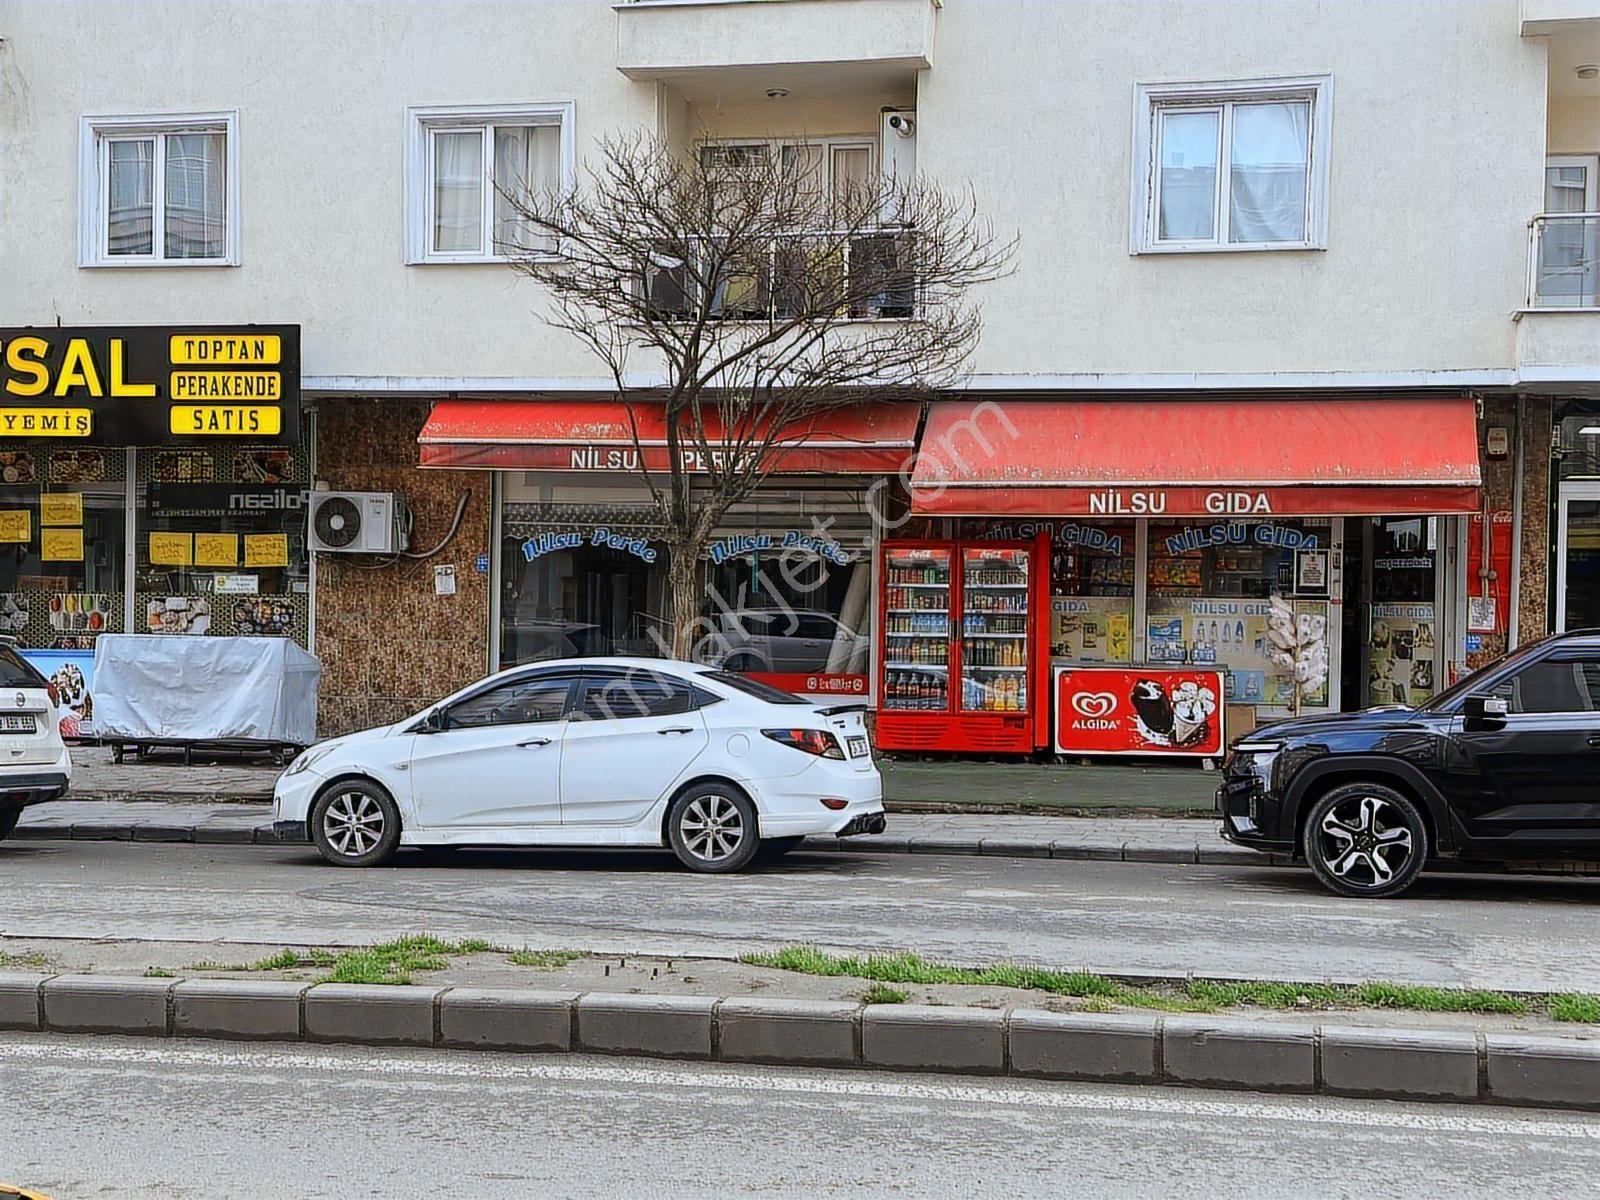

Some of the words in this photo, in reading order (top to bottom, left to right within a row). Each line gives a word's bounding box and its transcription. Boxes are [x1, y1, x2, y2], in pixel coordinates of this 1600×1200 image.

[184, 340, 265, 360] TOPTAN
[0, 337, 156, 396] SAL
[176, 376, 276, 396] PERAKENDE
[4, 411, 89, 435] YEMİŞ
[193, 409, 259, 432] SATIŞ
[571, 445, 638, 469] NİLSU
[1089, 489, 1167, 515] NİLSU
[1205, 491, 1273, 515] GIDA
[522, 531, 583, 562] Nilsu
[592, 527, 658, 564] Perde
[709, 533, 772, 566] Nilsu
[782, 529, 853, 566] Perde
[1061, 524, 1122, 556] GIDA
[1166, 523, 1247, 557] NİLSU
[1254, 524, 1318, 557] GIDA
[1052, 600, 1089, 613] GIDA
[1243, 603, 1271, 616] GID
[1407, 605, 1434, 618] GIDA
